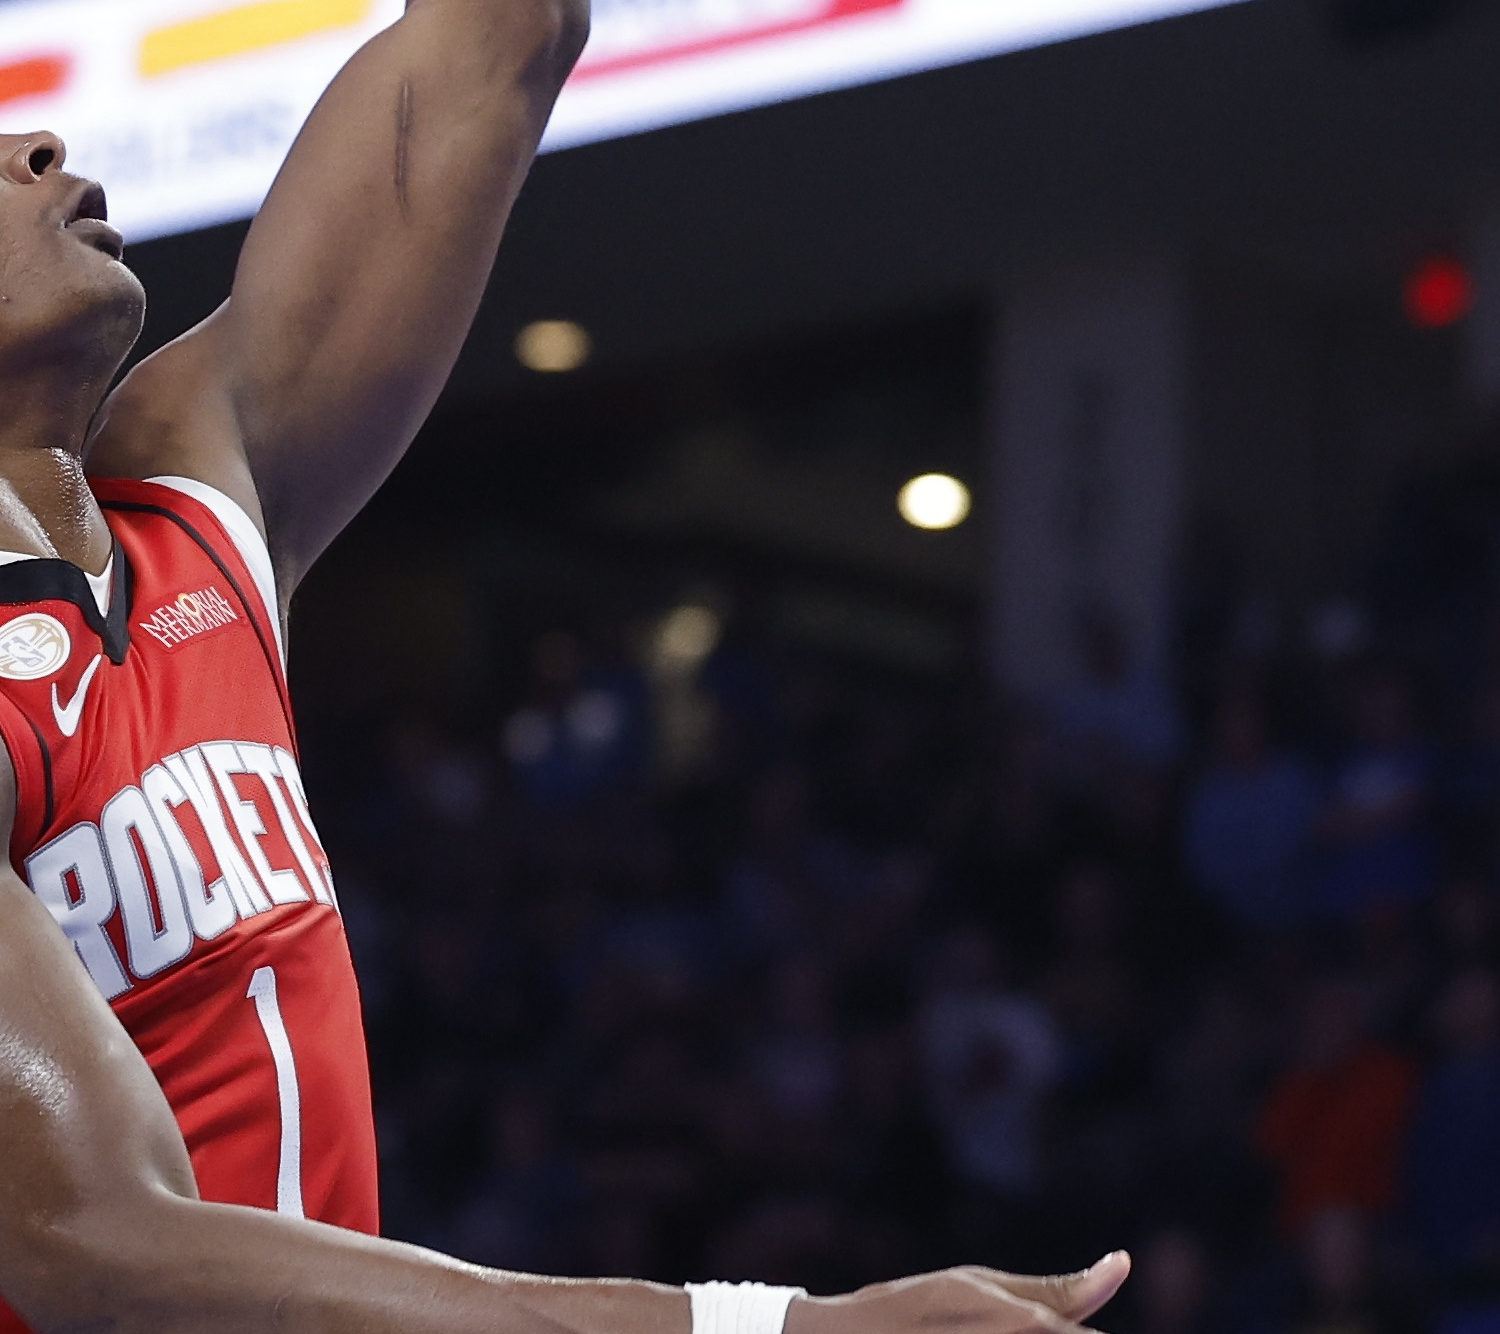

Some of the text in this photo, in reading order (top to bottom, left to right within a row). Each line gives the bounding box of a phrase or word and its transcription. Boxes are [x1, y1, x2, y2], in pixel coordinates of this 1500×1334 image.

[138, 586, 228, 637] MEMORIAL
[160, 598, 238, 648] HERMANN
[246, 966, 305, 1219] 1
